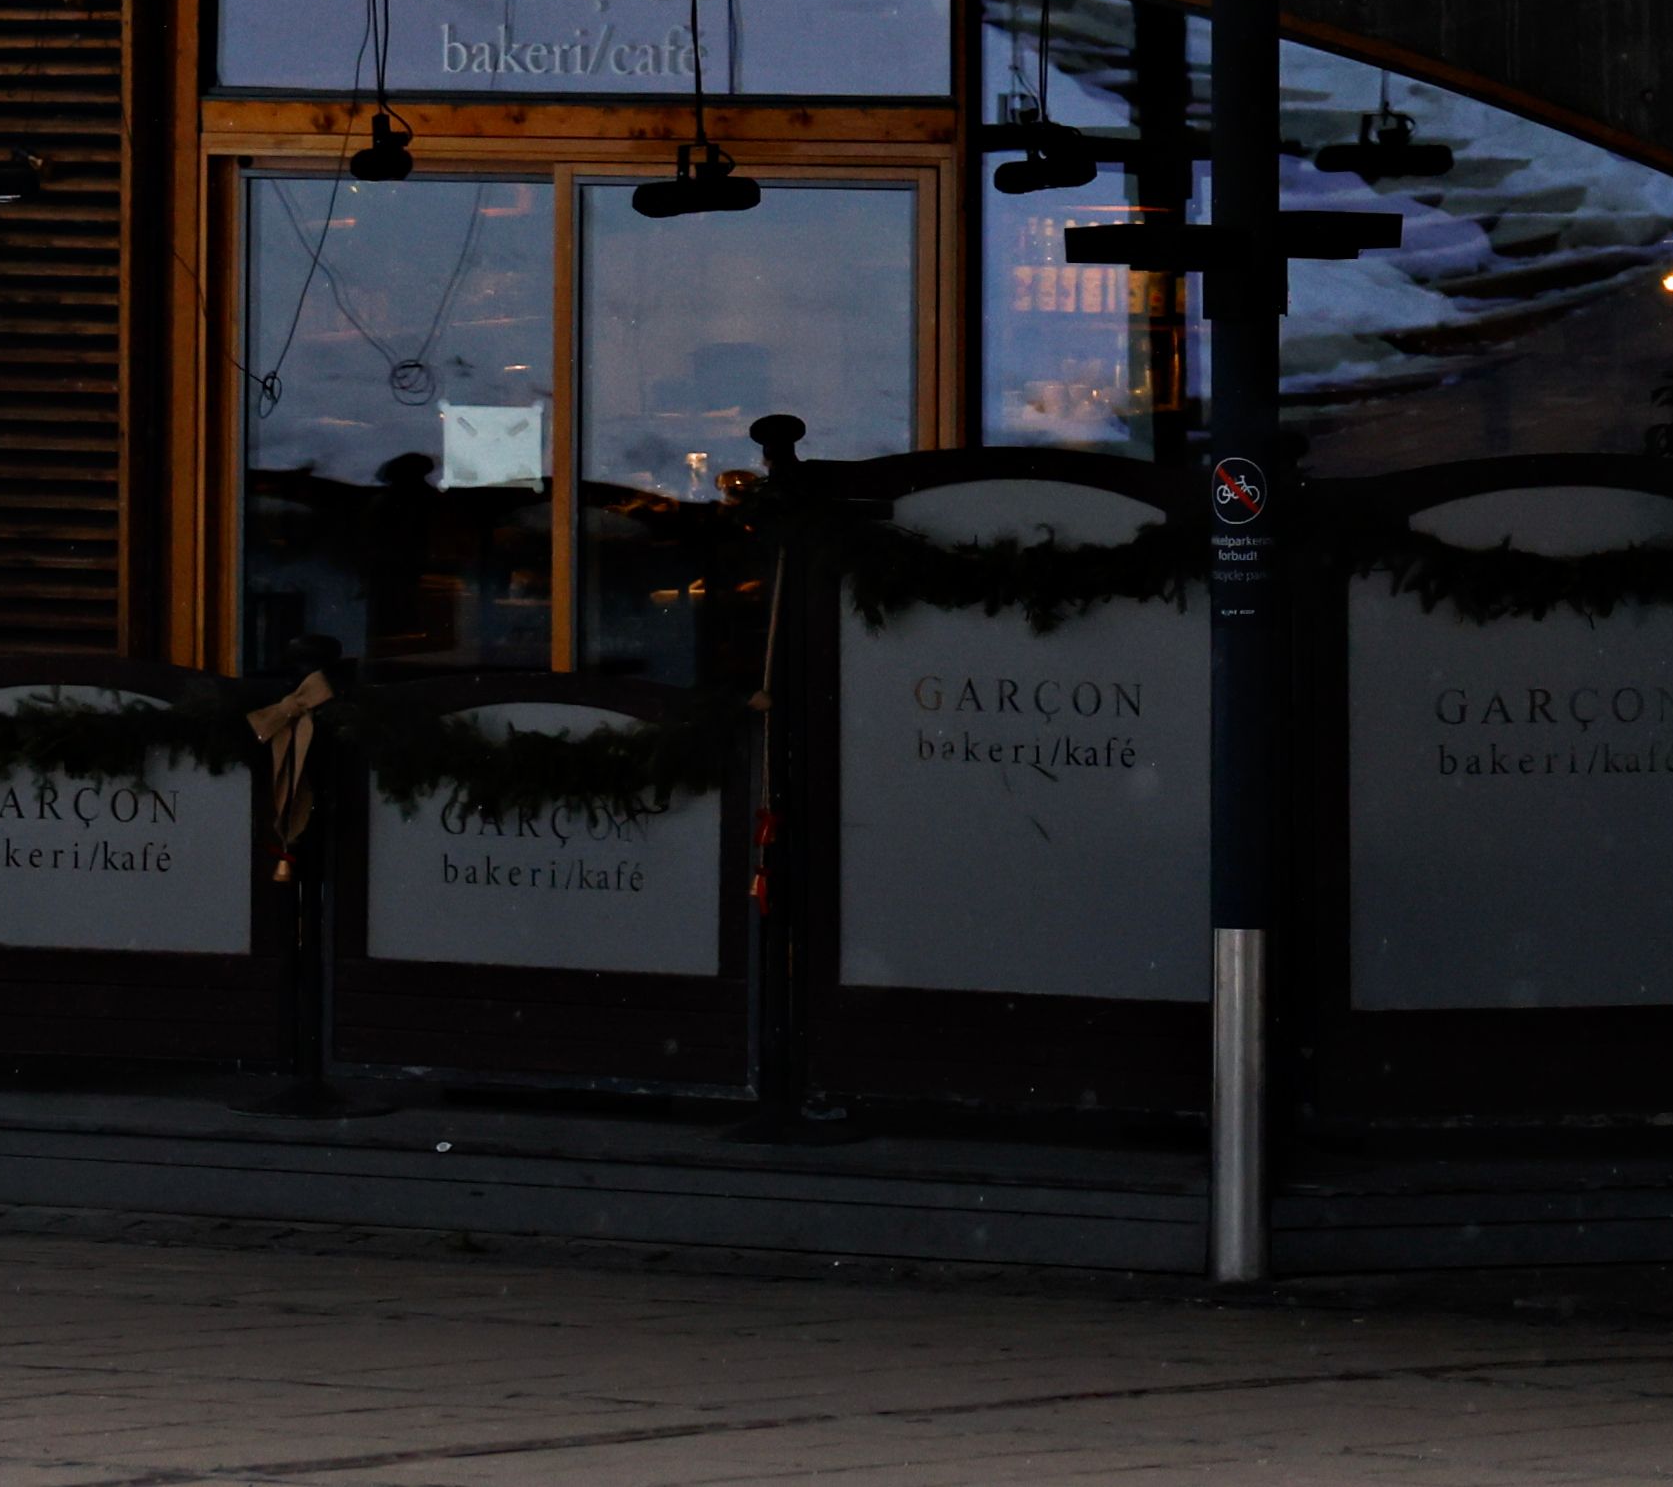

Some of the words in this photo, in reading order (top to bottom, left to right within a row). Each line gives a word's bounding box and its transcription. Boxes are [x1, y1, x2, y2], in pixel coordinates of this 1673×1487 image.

[442, 23, 707, 75] bakeri/café
[1217, 548, 1258, 562] forbudt
[914, 675, 1143, 723] GARÇON
[917, 730, 1136, 768] bakeri/kafé
[442, 854, 644, 891] bakeri/kafé
